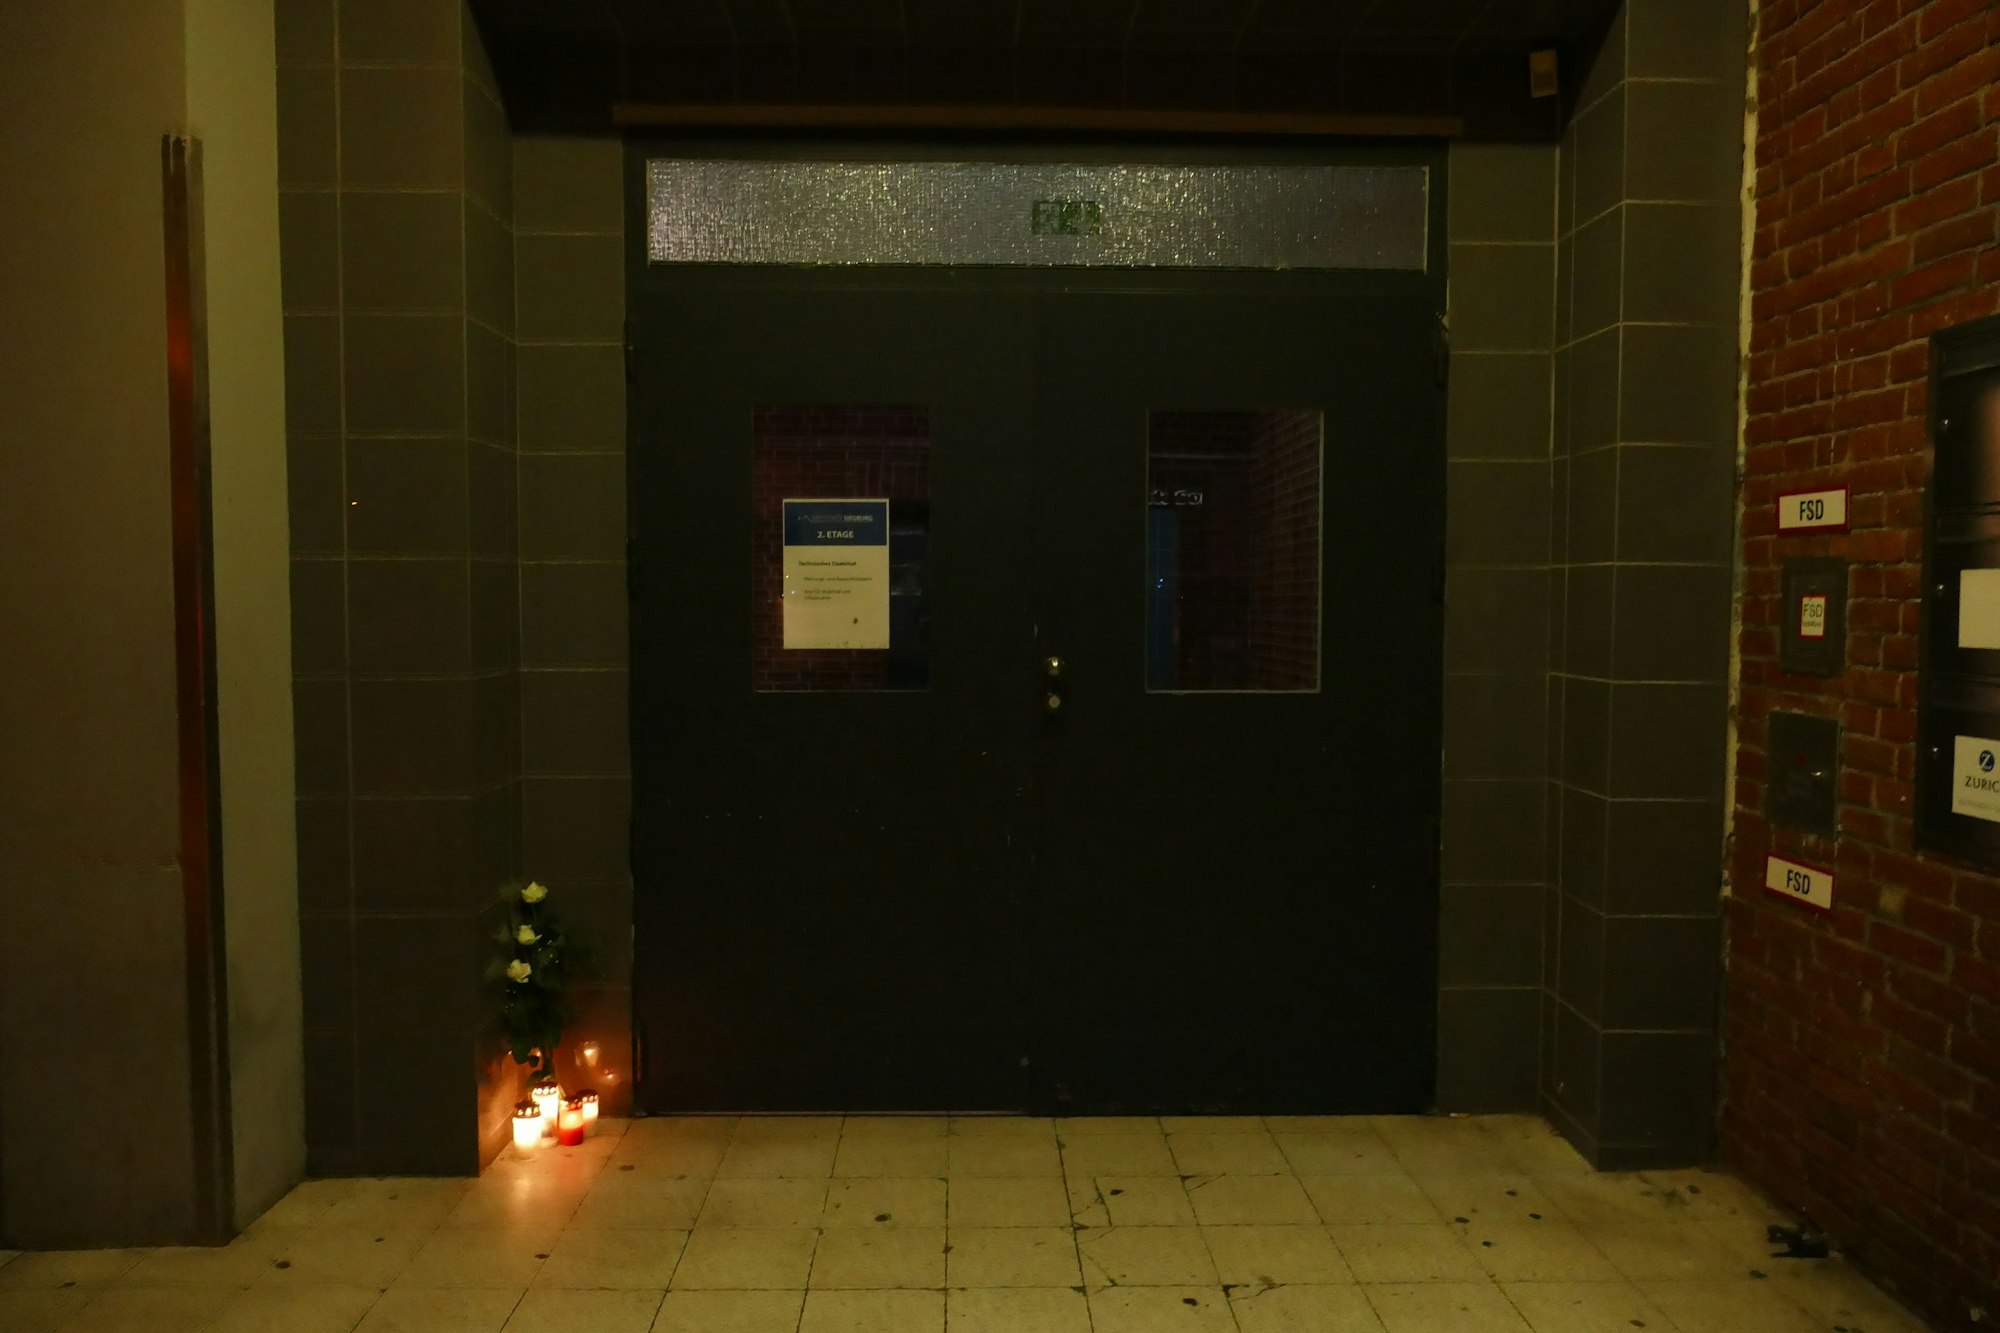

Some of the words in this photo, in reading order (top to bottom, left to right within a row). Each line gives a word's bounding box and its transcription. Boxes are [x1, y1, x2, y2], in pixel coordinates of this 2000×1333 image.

[1799, 499, 1824, 521] FSD
[817, 530, 826, 539] 2.
[826, 530, 855, 539] ETAGE
[1802, 603, 1823, 617] FSD
[1964, 776, 2000, 793] ZURIC
[1786, 869, 1811, 895] FSD
